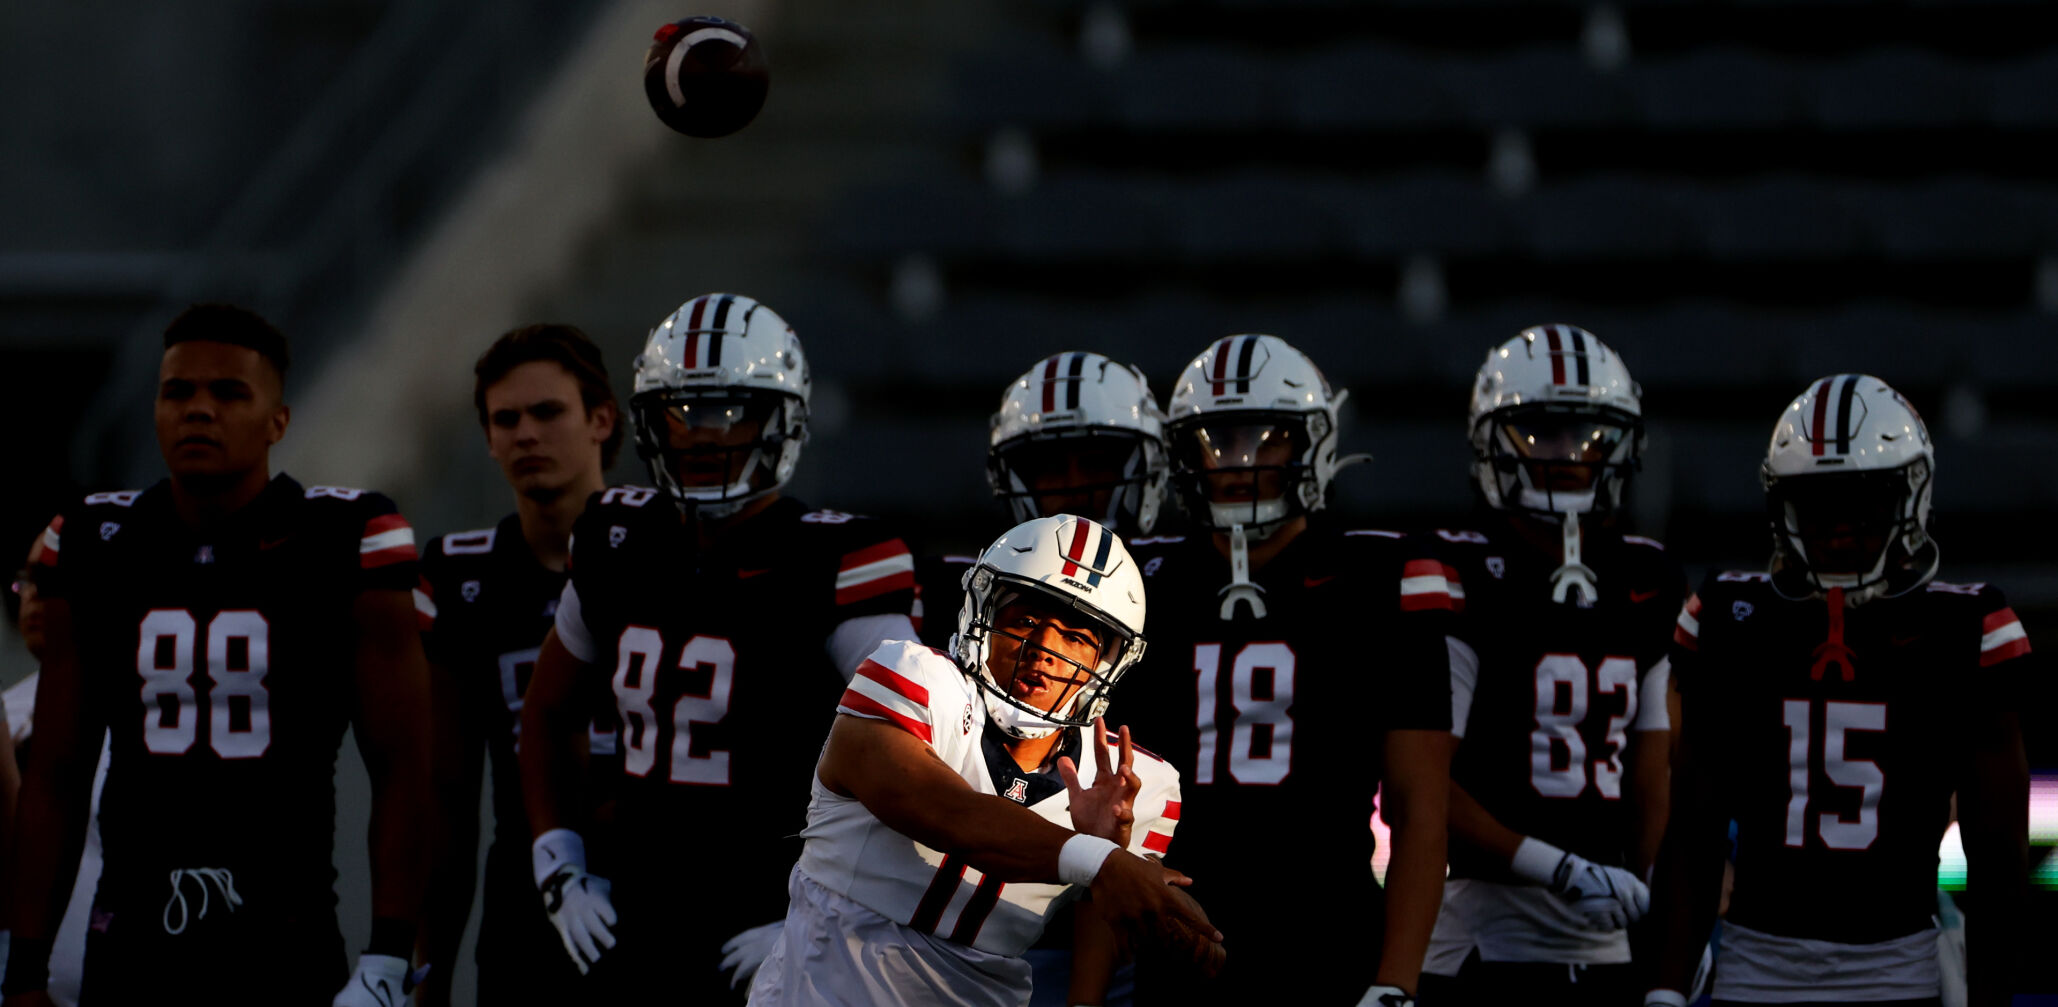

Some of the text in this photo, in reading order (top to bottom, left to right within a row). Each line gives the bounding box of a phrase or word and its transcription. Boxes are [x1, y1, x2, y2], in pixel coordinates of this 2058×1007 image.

[137, 607, 272, 759] 88
[611, 623, 737, 786] 82
[1192, 641, 1297, 787] 18
[1529, 652, 1638, 800] 83
[1004, 778, 1028, 803] A
[1781, 698, 1888, 850] 15
